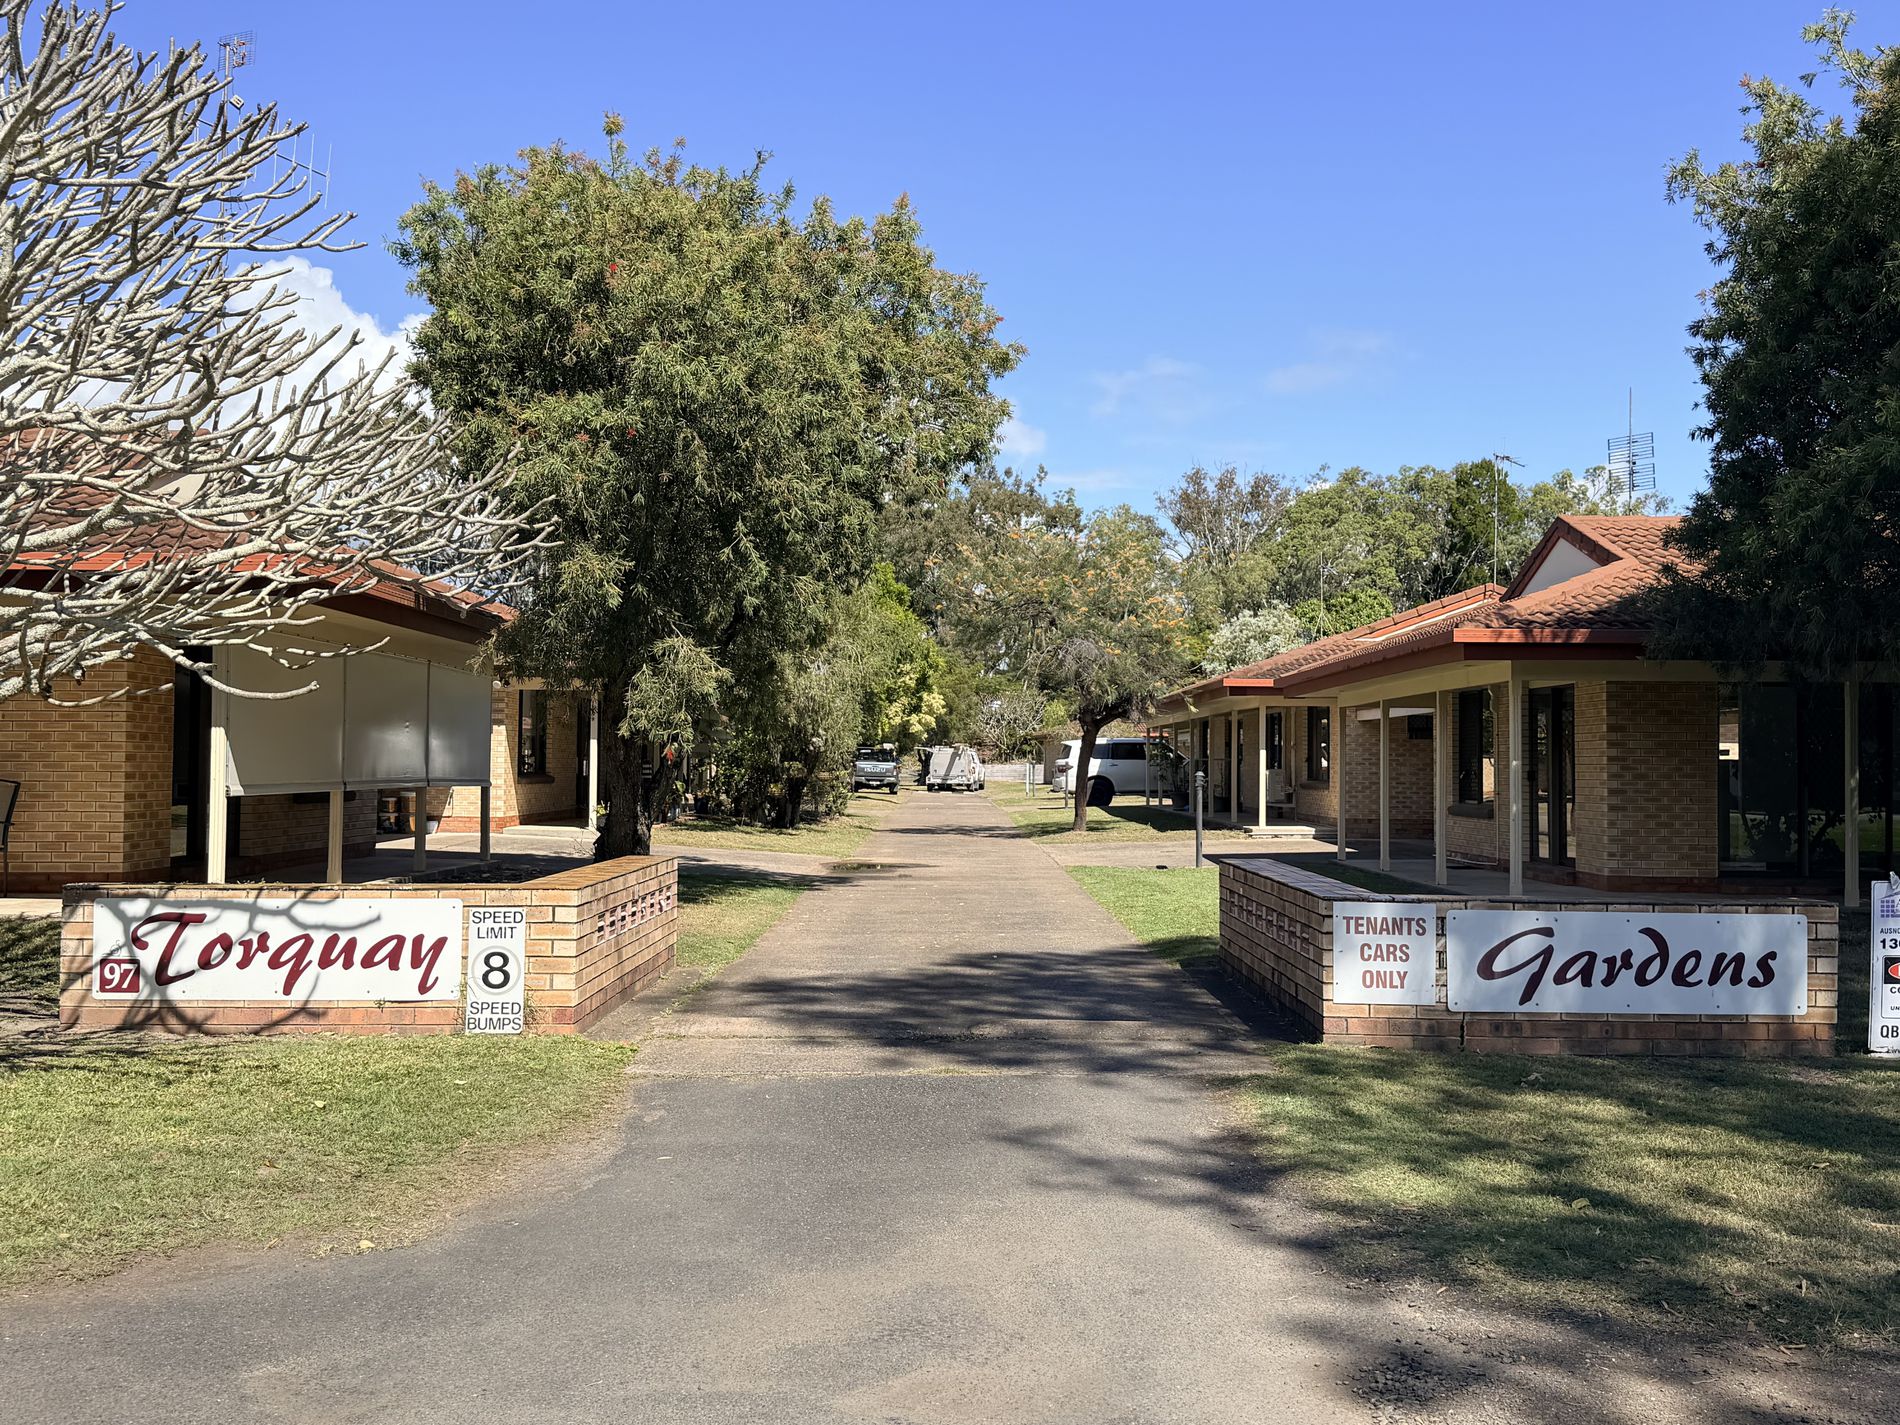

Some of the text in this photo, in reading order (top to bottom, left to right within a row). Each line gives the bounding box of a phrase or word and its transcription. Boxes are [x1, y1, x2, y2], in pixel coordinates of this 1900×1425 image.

[472, 910, 524, 924] SPEED
[1342, 916, 1427, 936] TENANTS
[477, 926, 517, 939] LIMIT
[131, 911, 447, 996] Torquay
[1360, 943, 1410, 962] CARS
[1880, 938, 1900, 950] 13
[103, 962, 138, 989] 97
[481, 951, 510, 989] 8
[1477, 927, 1777, 1006] Gardens
[1362, 970, 1408, 989] ONLY
[469, 1001, 521, 1015] SPEED
[467, 1017, 521, 1031] BUMPS
